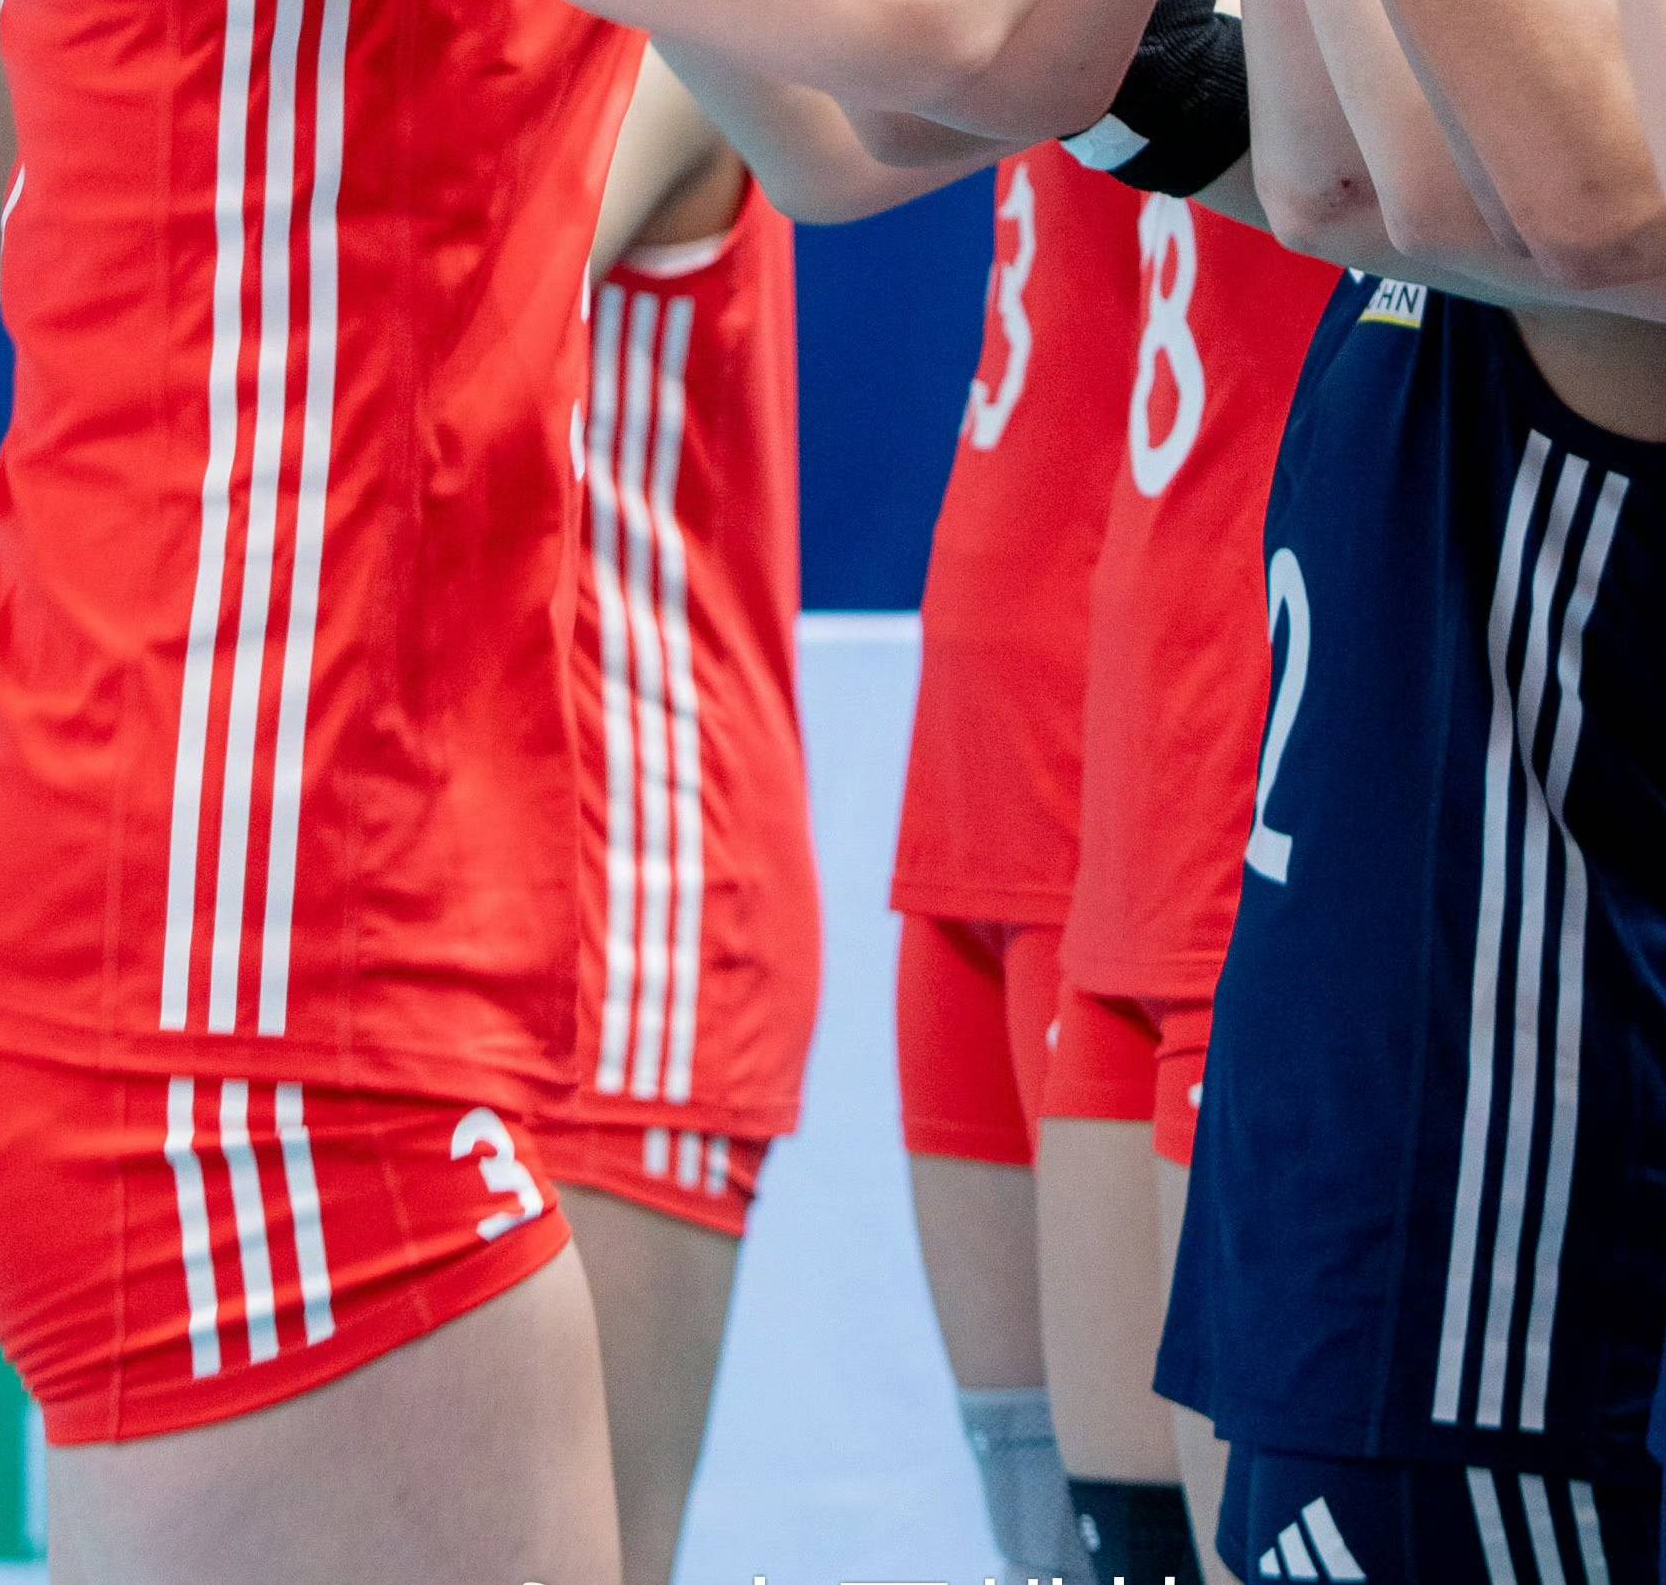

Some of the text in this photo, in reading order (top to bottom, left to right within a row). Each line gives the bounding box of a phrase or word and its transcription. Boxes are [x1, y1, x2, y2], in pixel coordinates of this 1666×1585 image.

[1129, 191, 1206, 498] 8
[1367, 282, 1420, 313] HN
[450, 1106, 545, 1243] 3
